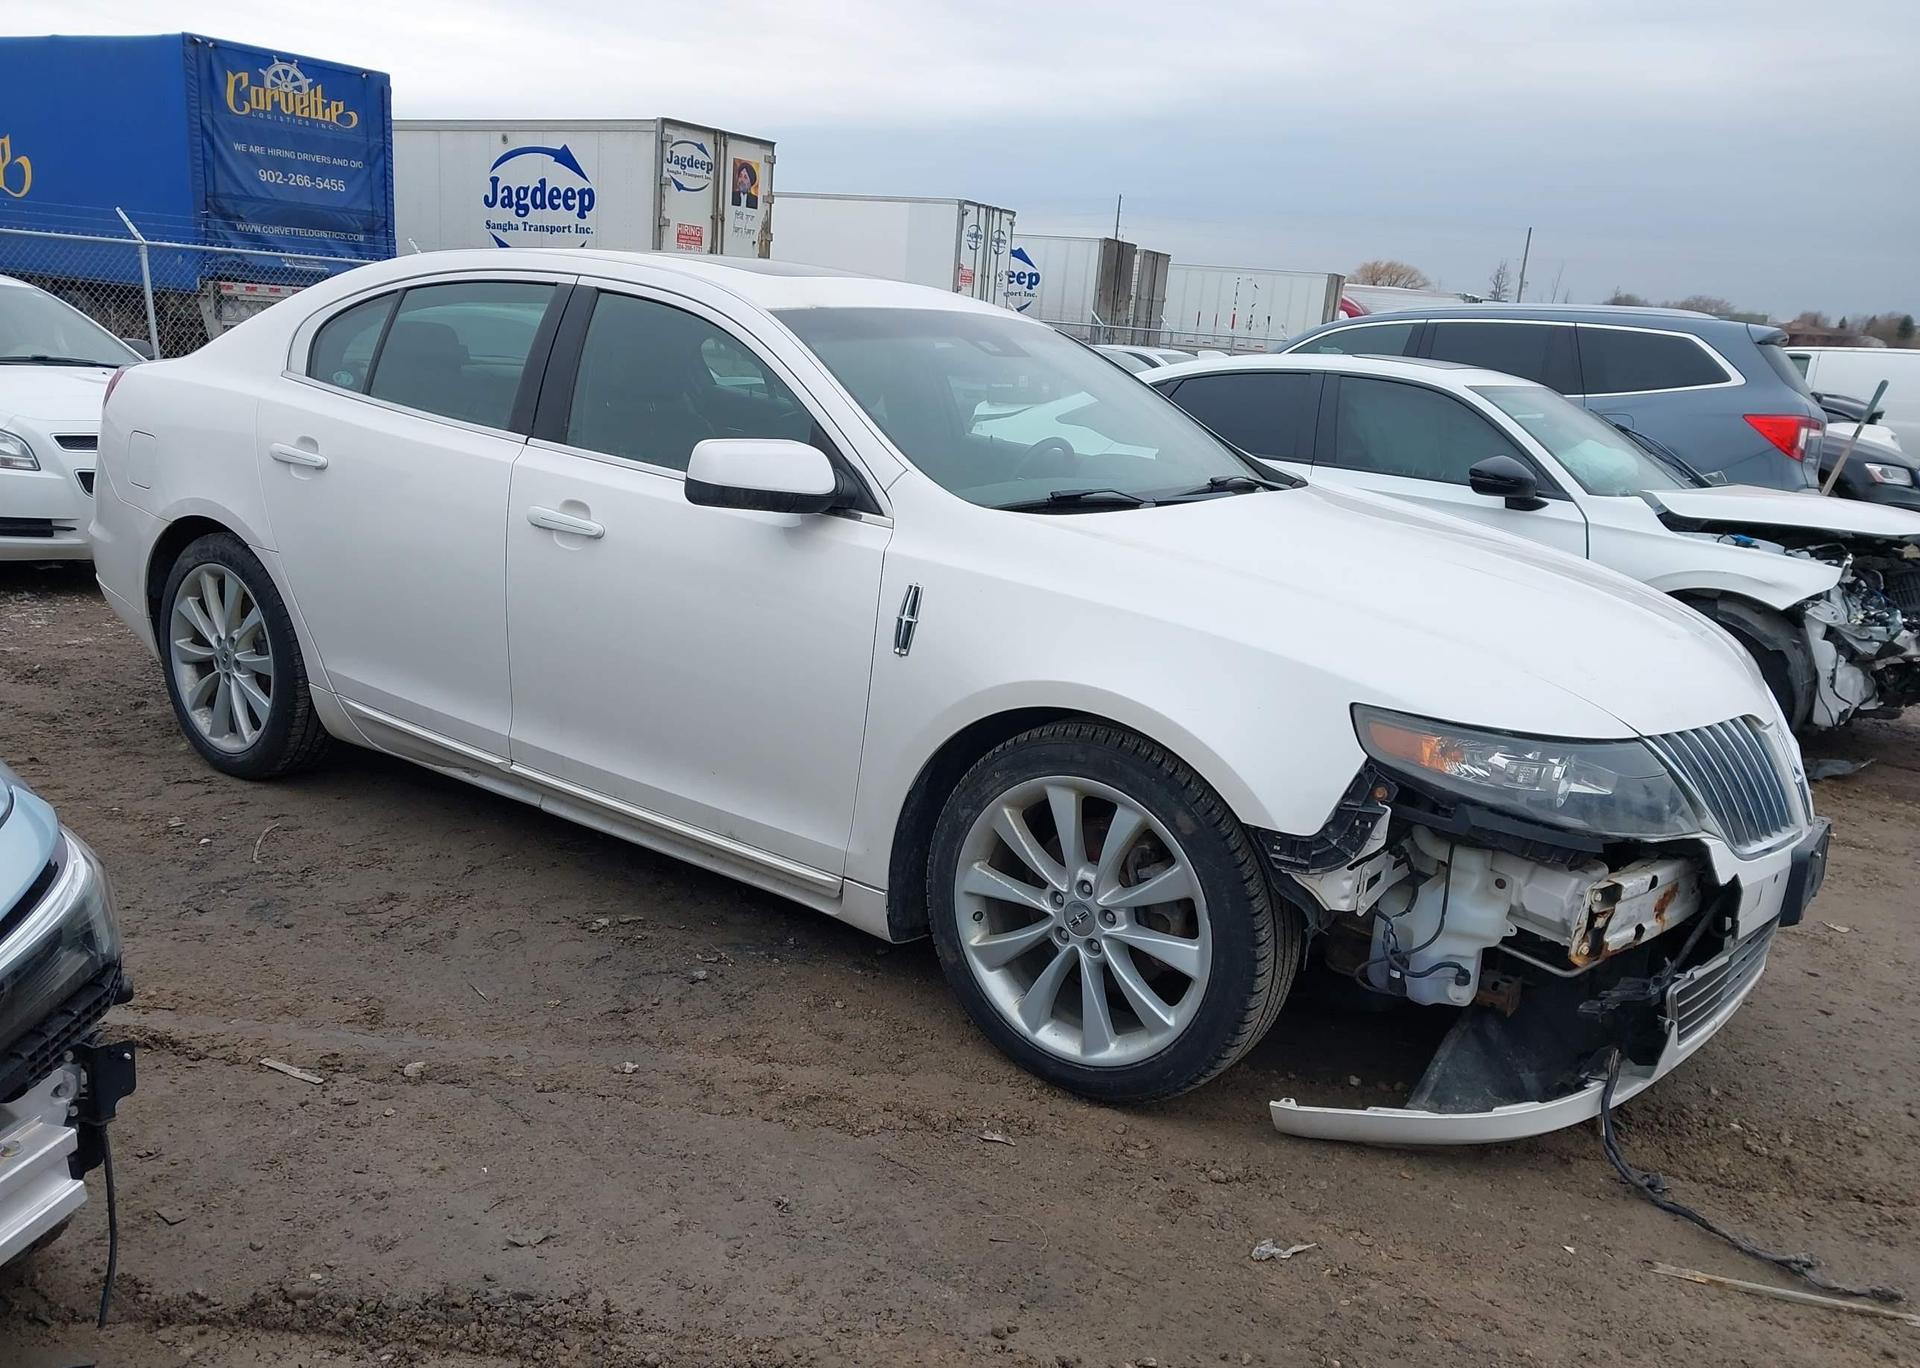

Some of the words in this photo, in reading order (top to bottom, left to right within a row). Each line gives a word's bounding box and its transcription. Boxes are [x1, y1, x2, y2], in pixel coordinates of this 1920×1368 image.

[226, 70, 359, 129] Corvette
[252, 111, 310, 126] LOGISTICS
[316, 123, 339, 131] INC.
[233, 142, 247, 152] WE
[249, 144, 266, 155] ARE
[268, 149, 296, 160] HIRING
[297, 152, 331, 164] DRIVERS
[332, 158, 350, 167] AND
[666, 150, 714, 175] Jagdeep
[258, 168, 346, 192] 902-266-5455
[483, 175, 596, 220] Jagdeep
[485, 219, 519, 233] Sangha
[522, 221, 572, 235] Transport
[575, 224, 594, 235] Inc.
